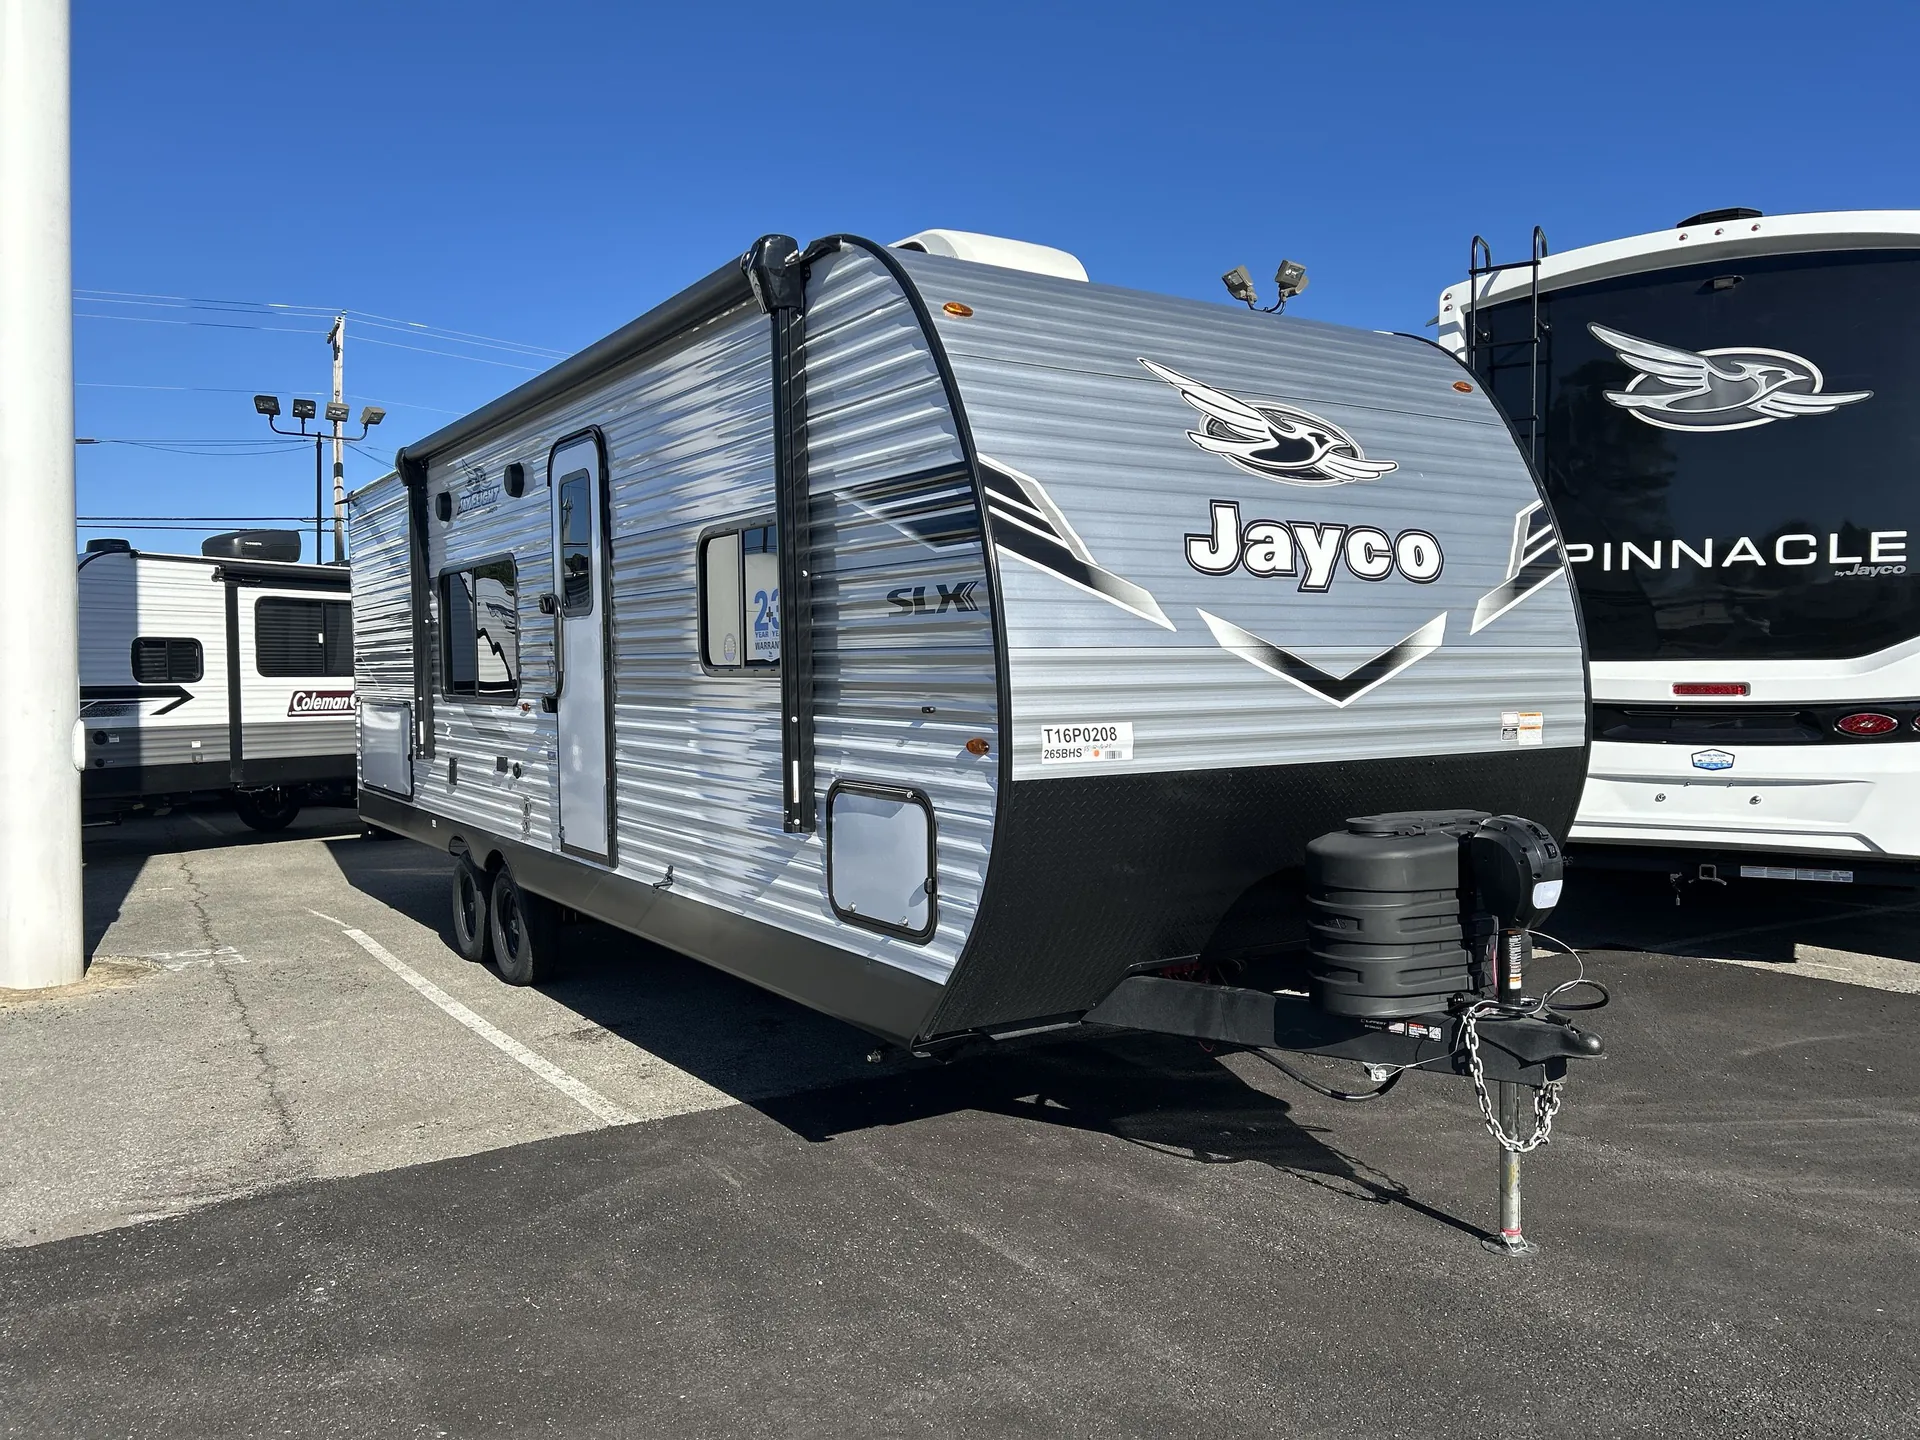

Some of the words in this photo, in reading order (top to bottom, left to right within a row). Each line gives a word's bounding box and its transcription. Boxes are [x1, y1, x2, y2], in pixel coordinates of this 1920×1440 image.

[1184, 499, 1444, 593] Jayco
[1564, 530, 1908, 571] PINNACLE
[1846, 563, 1907, 578] Jayco
[886, 581, 979, 617] SLX
[754, 640, 780, 650] WARRAN
[293, 692, 348, 711] Coleman
[1043, 726, 1118, 744] T16P0208
[1043, 748, 1082, 759] 265BHS
